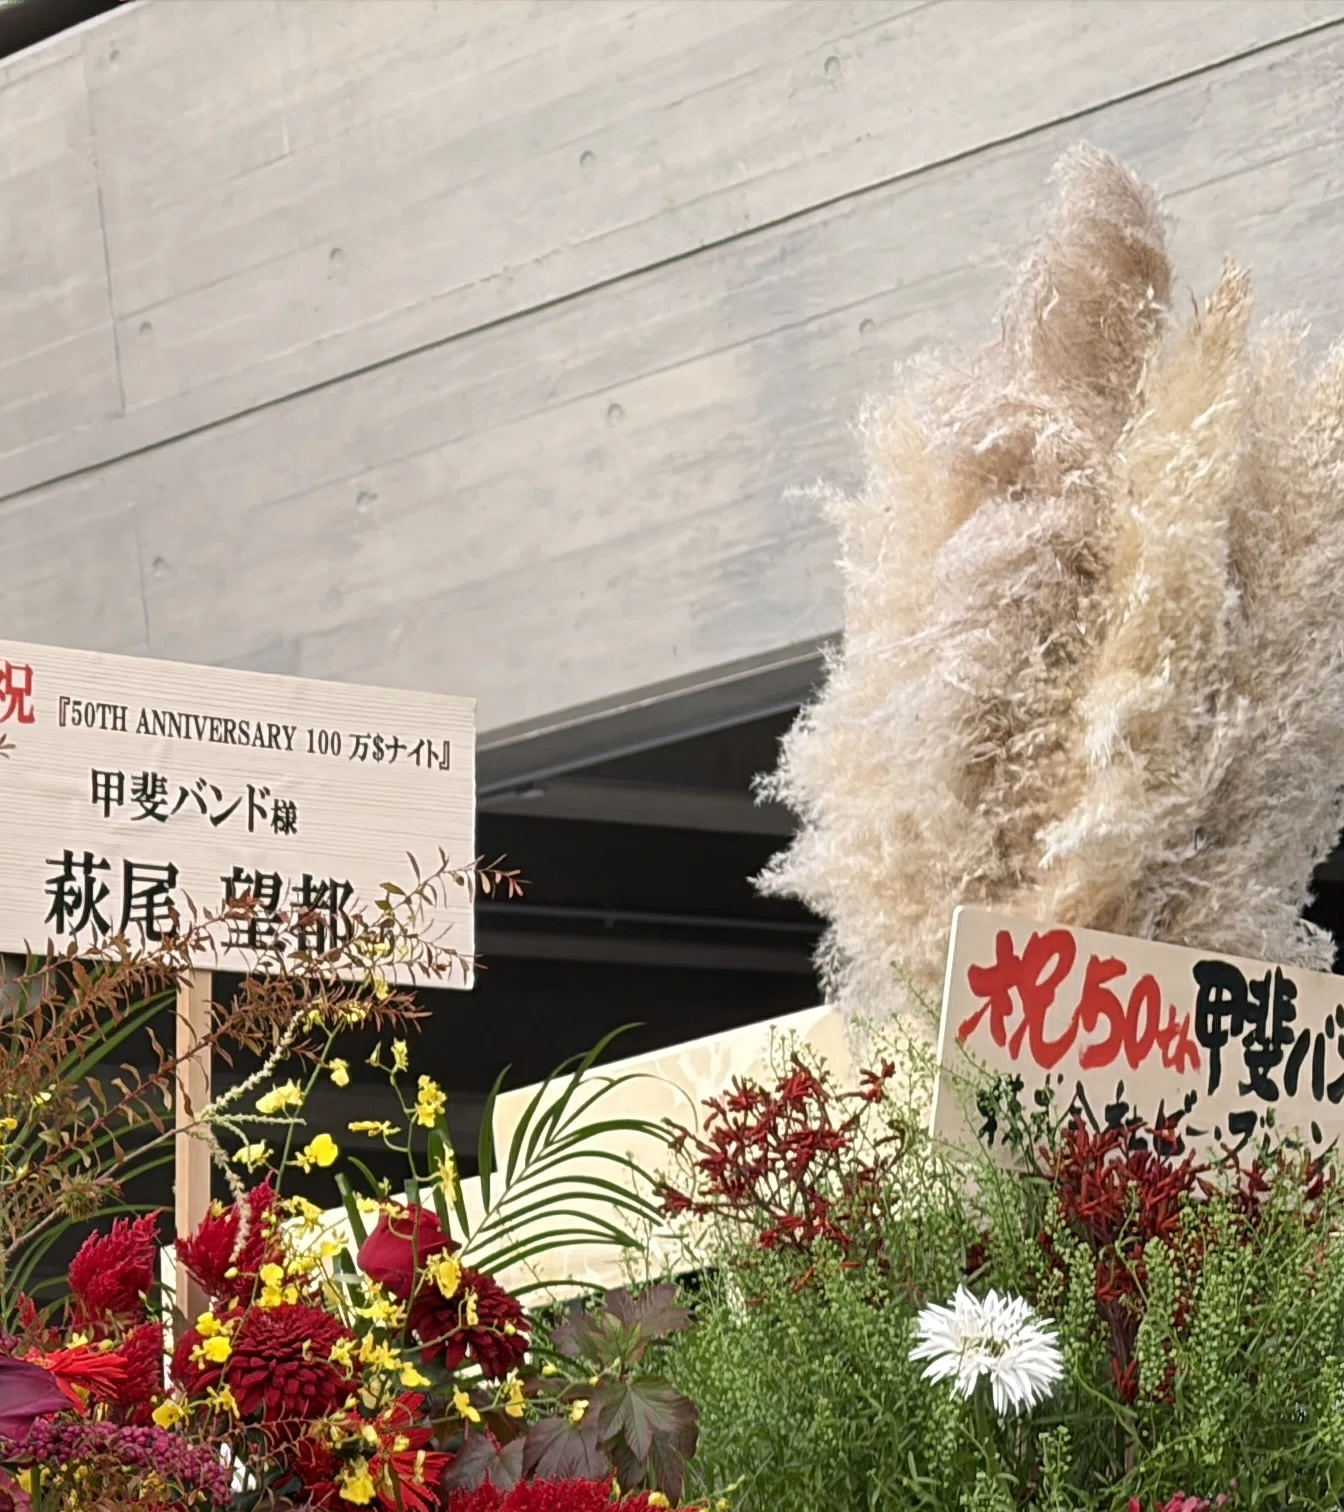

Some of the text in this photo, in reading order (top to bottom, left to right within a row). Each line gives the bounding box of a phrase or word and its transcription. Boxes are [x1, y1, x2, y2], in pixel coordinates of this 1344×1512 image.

[135, 708, 297, 752] ANNIVERSARY
[91, 769, 298, 835] 甲斐バンド様
[44, 849, 179, 941] 萩尾
